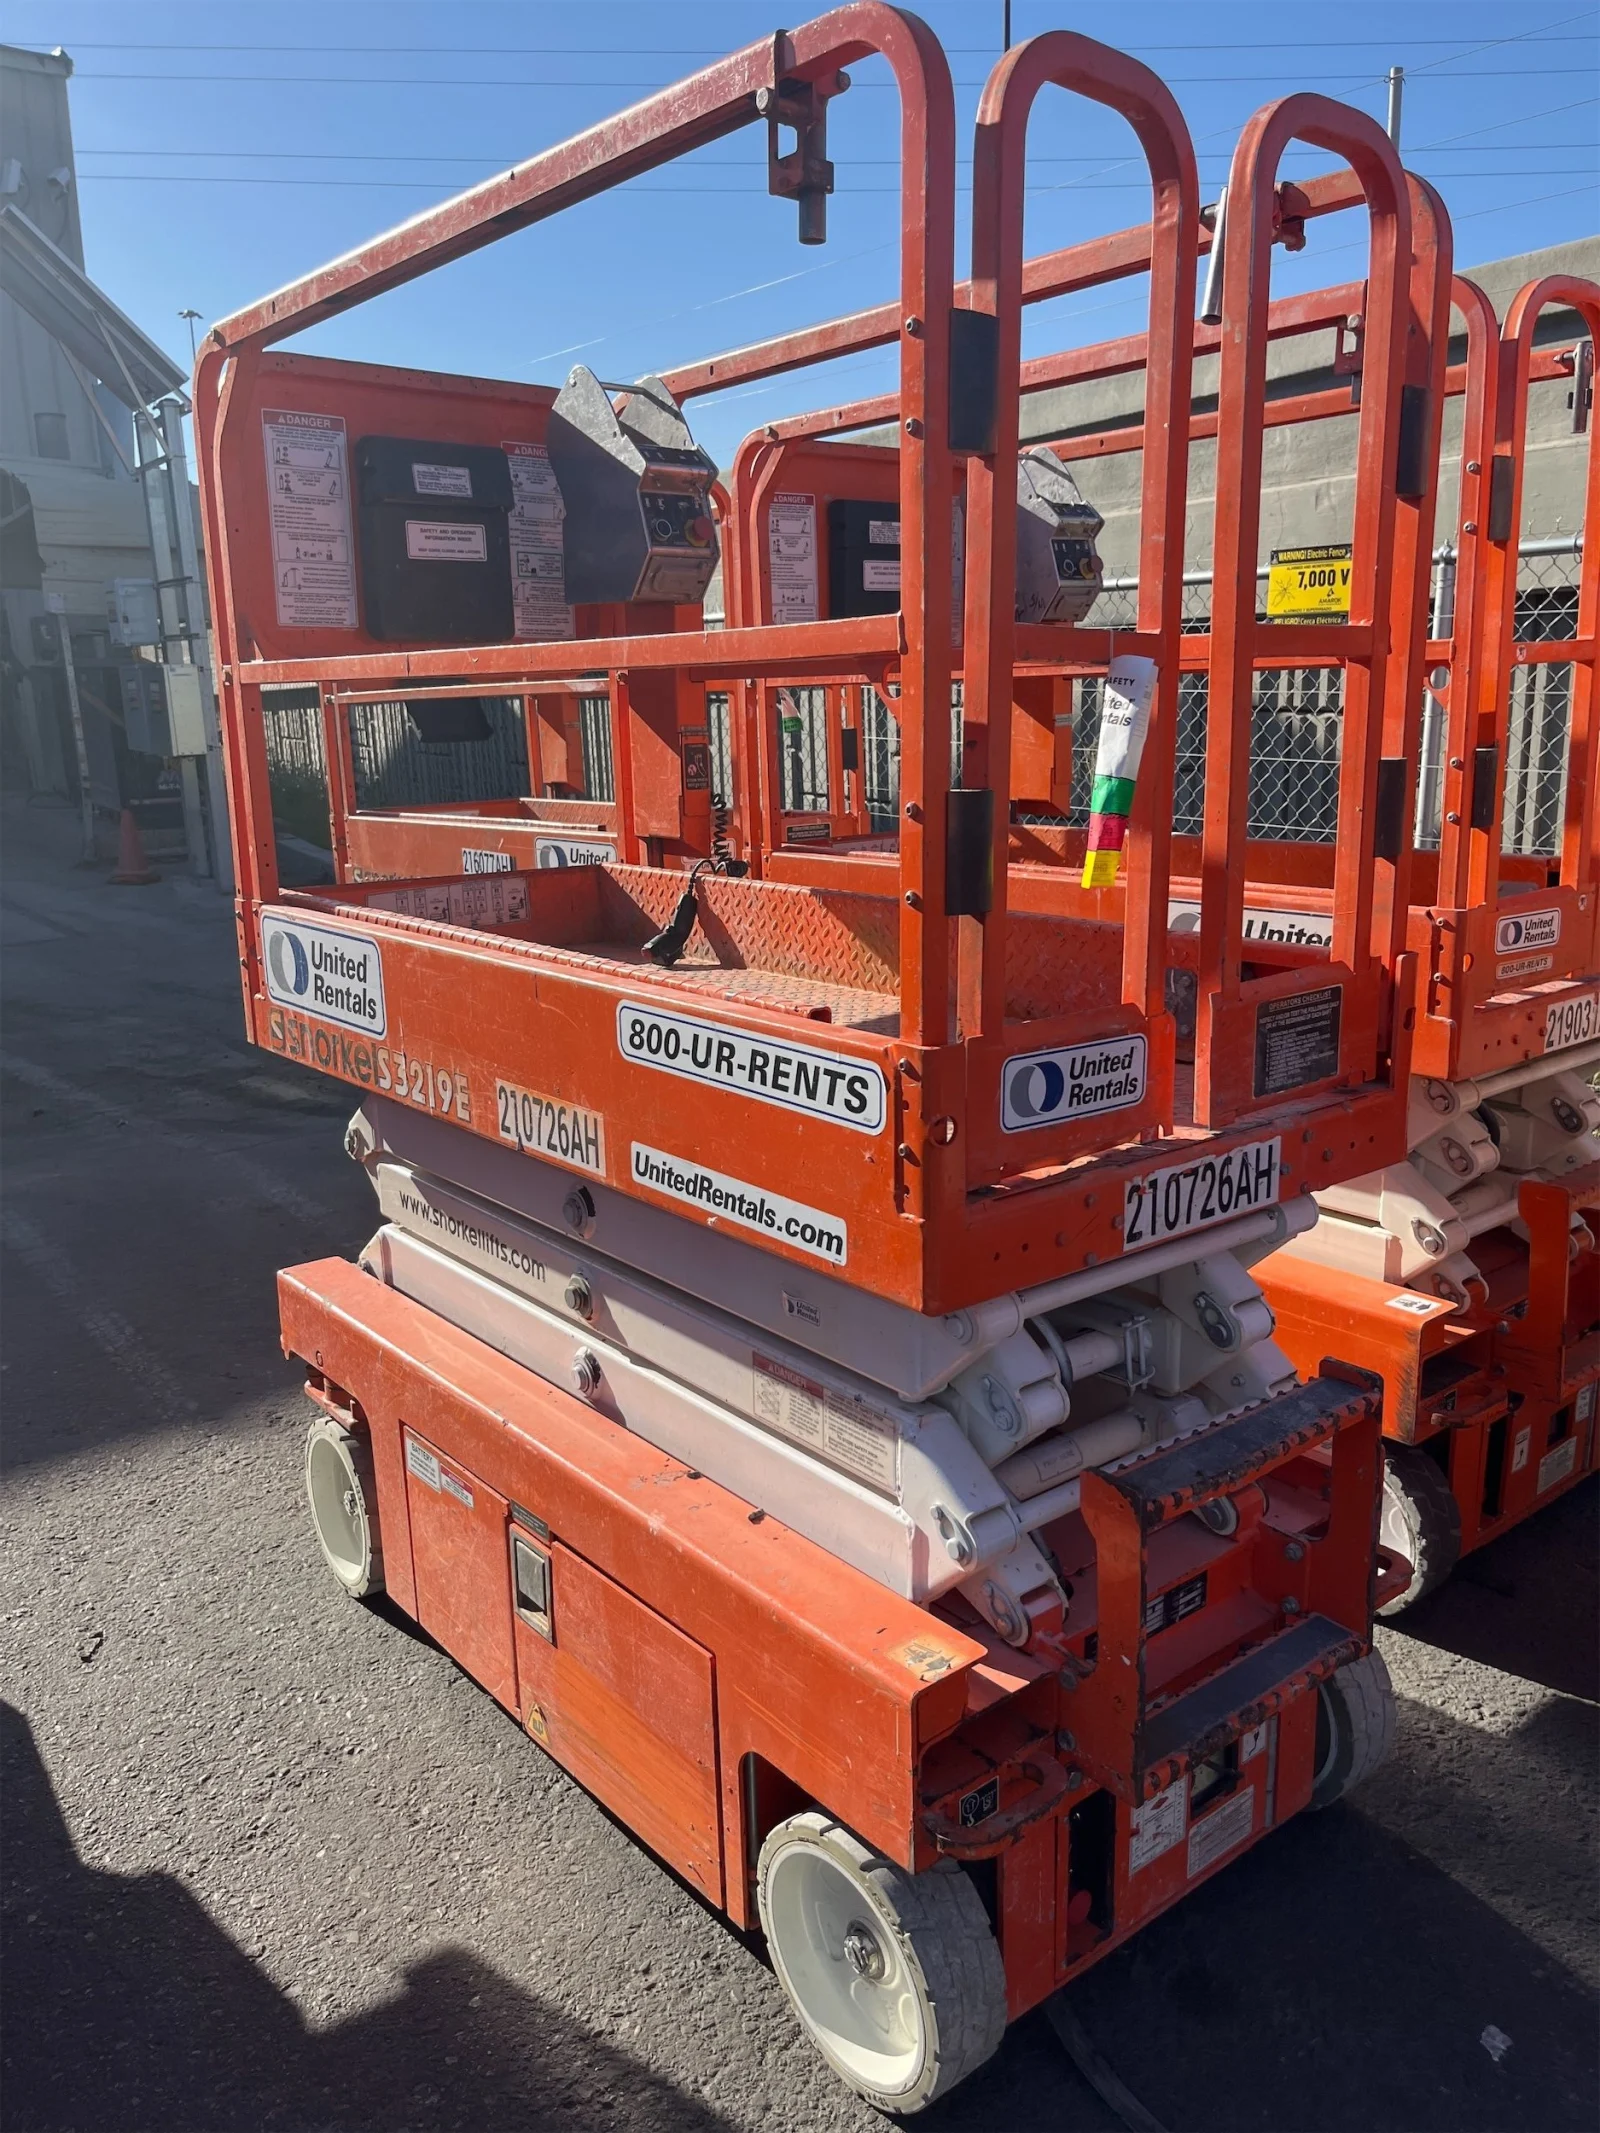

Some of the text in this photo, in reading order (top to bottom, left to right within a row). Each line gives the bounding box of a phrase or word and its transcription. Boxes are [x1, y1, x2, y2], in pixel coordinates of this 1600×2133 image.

[287, 415, 331, 428] DANGER
[520, 446, 549, 457] DANG
[1278, 547, 1347, 561] WARNING! Electric Fence
[1297, 568, 1350, 590] 7,000 V
[569, 847, 610, 866] United
[1245, 919, 1333, 948] Unite
[1523, 927, 1556, 944] Rentals
[1524, 915, 1554, 931] United
[311, 940, 368, 984] United
[1500, 956, 1549, 975] 800-UR-RENTS
[313, 973, 377, 1021] Rentals
[1545, 998, 1600, 1049] 219031
[628, 1018, 870, 1115] 800-UR-RENTS
[1069, 1046, 1134, 1081] United
[377, 1046, 472, 1122] S3219E
[1068, 1072, 1139, 1108] Rentals
[498, 1084, 601, 1169] 210726AH
[634, 1150, 844, 1256] UnitedRentals.com
[1126, 1143, 1274, 1244] 210726AH
[399, 1189, 547, 1283] www.snorkellifts.com
[796, 1301, 818, 1315] United
[796, 1308, 819, 1324] Rentals
[774, 1366, 808, 1388] DANGER
